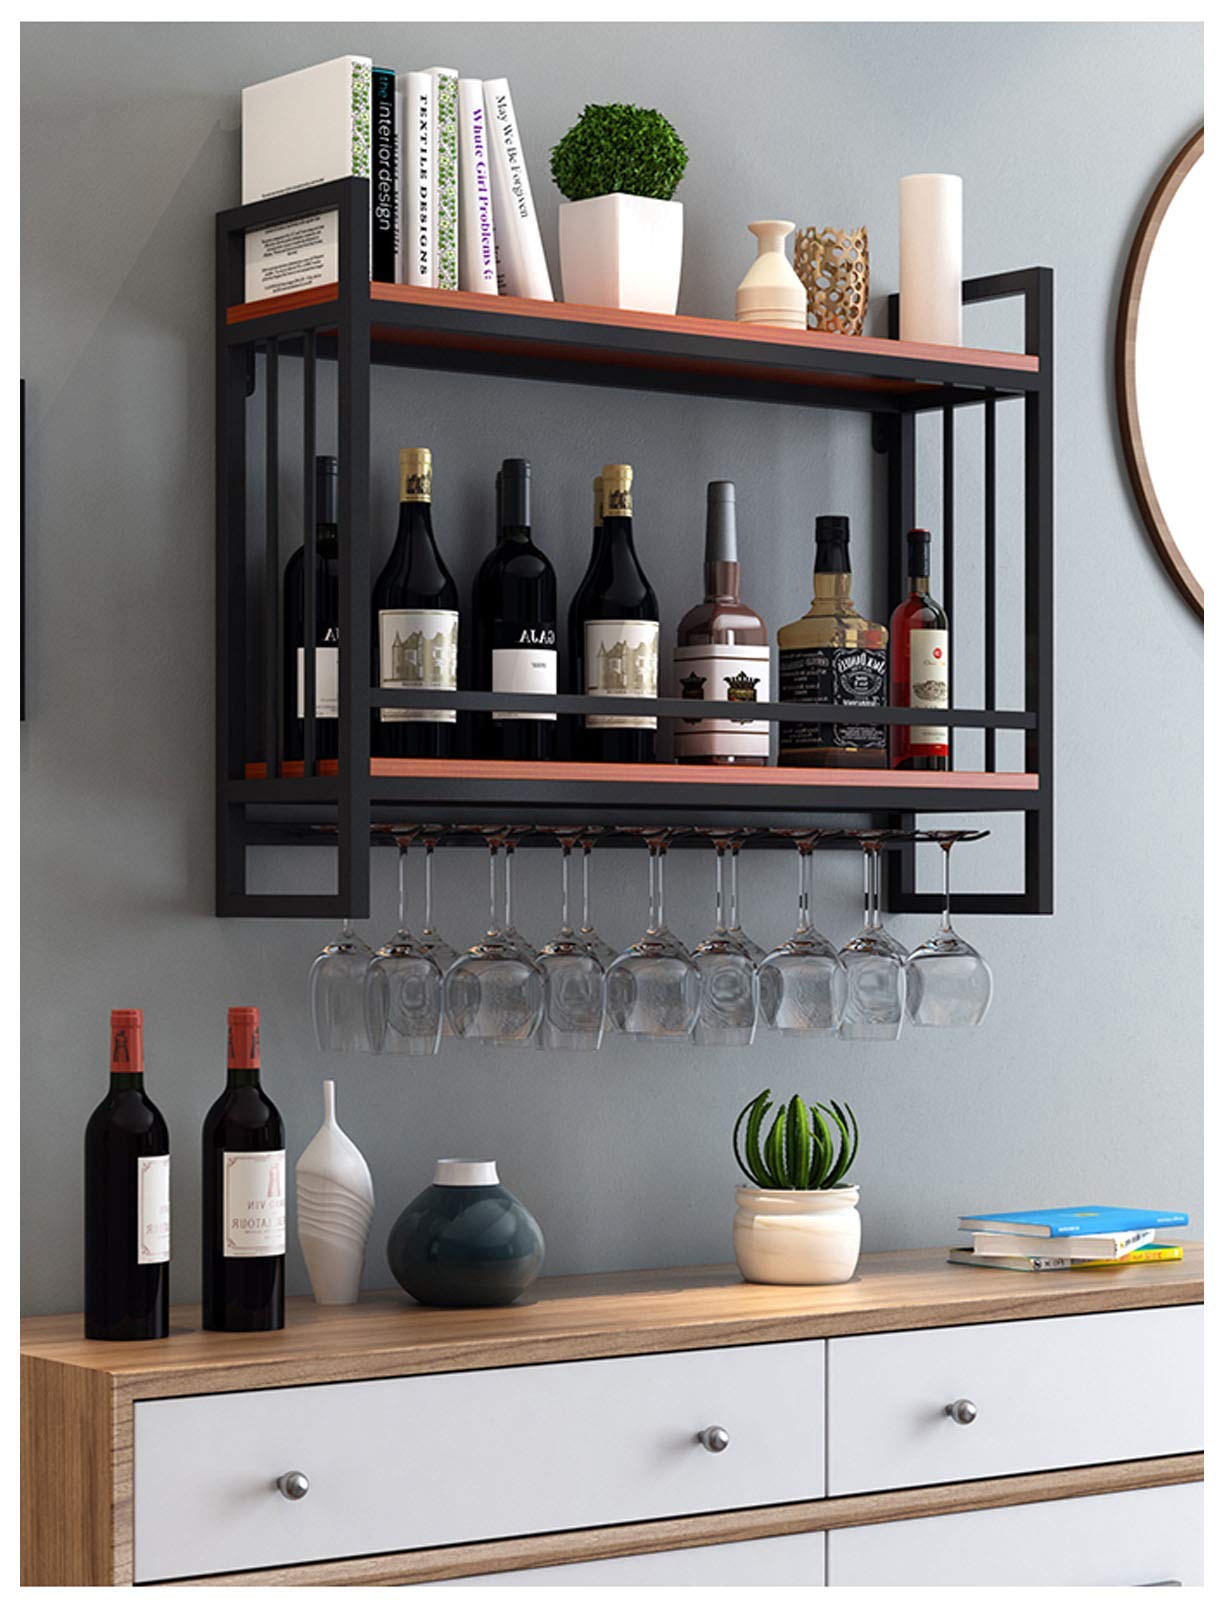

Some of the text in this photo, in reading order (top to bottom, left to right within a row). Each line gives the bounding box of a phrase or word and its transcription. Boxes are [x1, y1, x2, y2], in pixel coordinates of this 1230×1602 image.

[379, 76, 389, 98] the
[419, 95, 428, 275] TEXTILE DESIGNS
[476, 160, 488, 192] Girl
[496, 95, 528, 218] May We Be Forgiven
[478, 196, 491, 266] Problems
